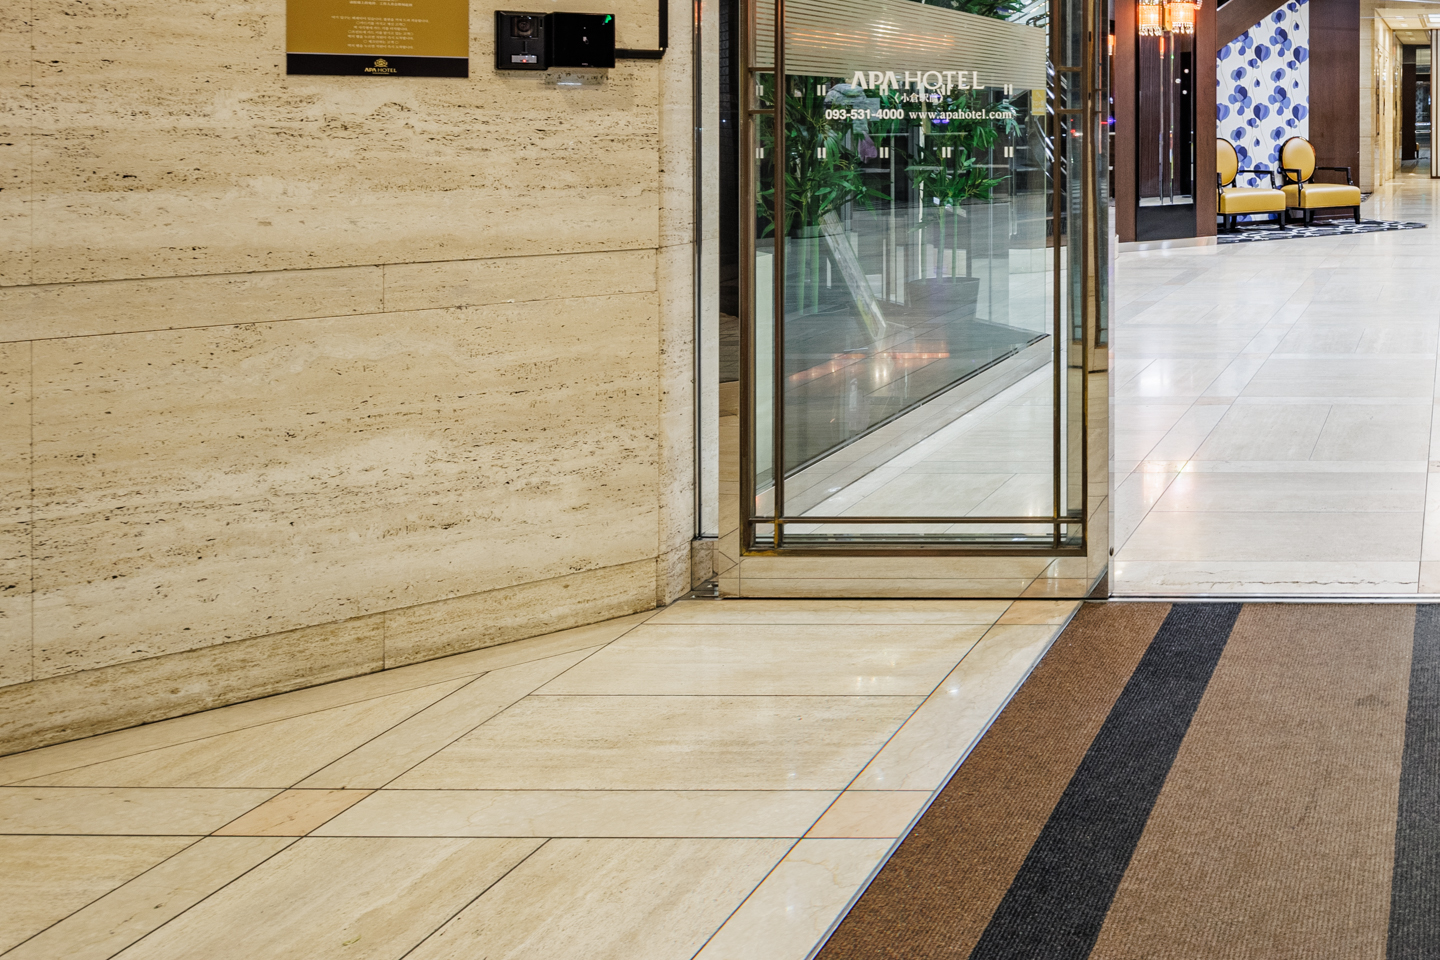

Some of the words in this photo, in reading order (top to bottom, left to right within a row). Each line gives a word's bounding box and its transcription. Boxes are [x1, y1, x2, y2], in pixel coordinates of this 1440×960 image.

[850, 70, 899, 90] APA
[903, 70, 985, 90] HOTEL
[825, 108, 904, 120] 093-531-4000
[908, 108, 1013, 121] www.apahotel.com
